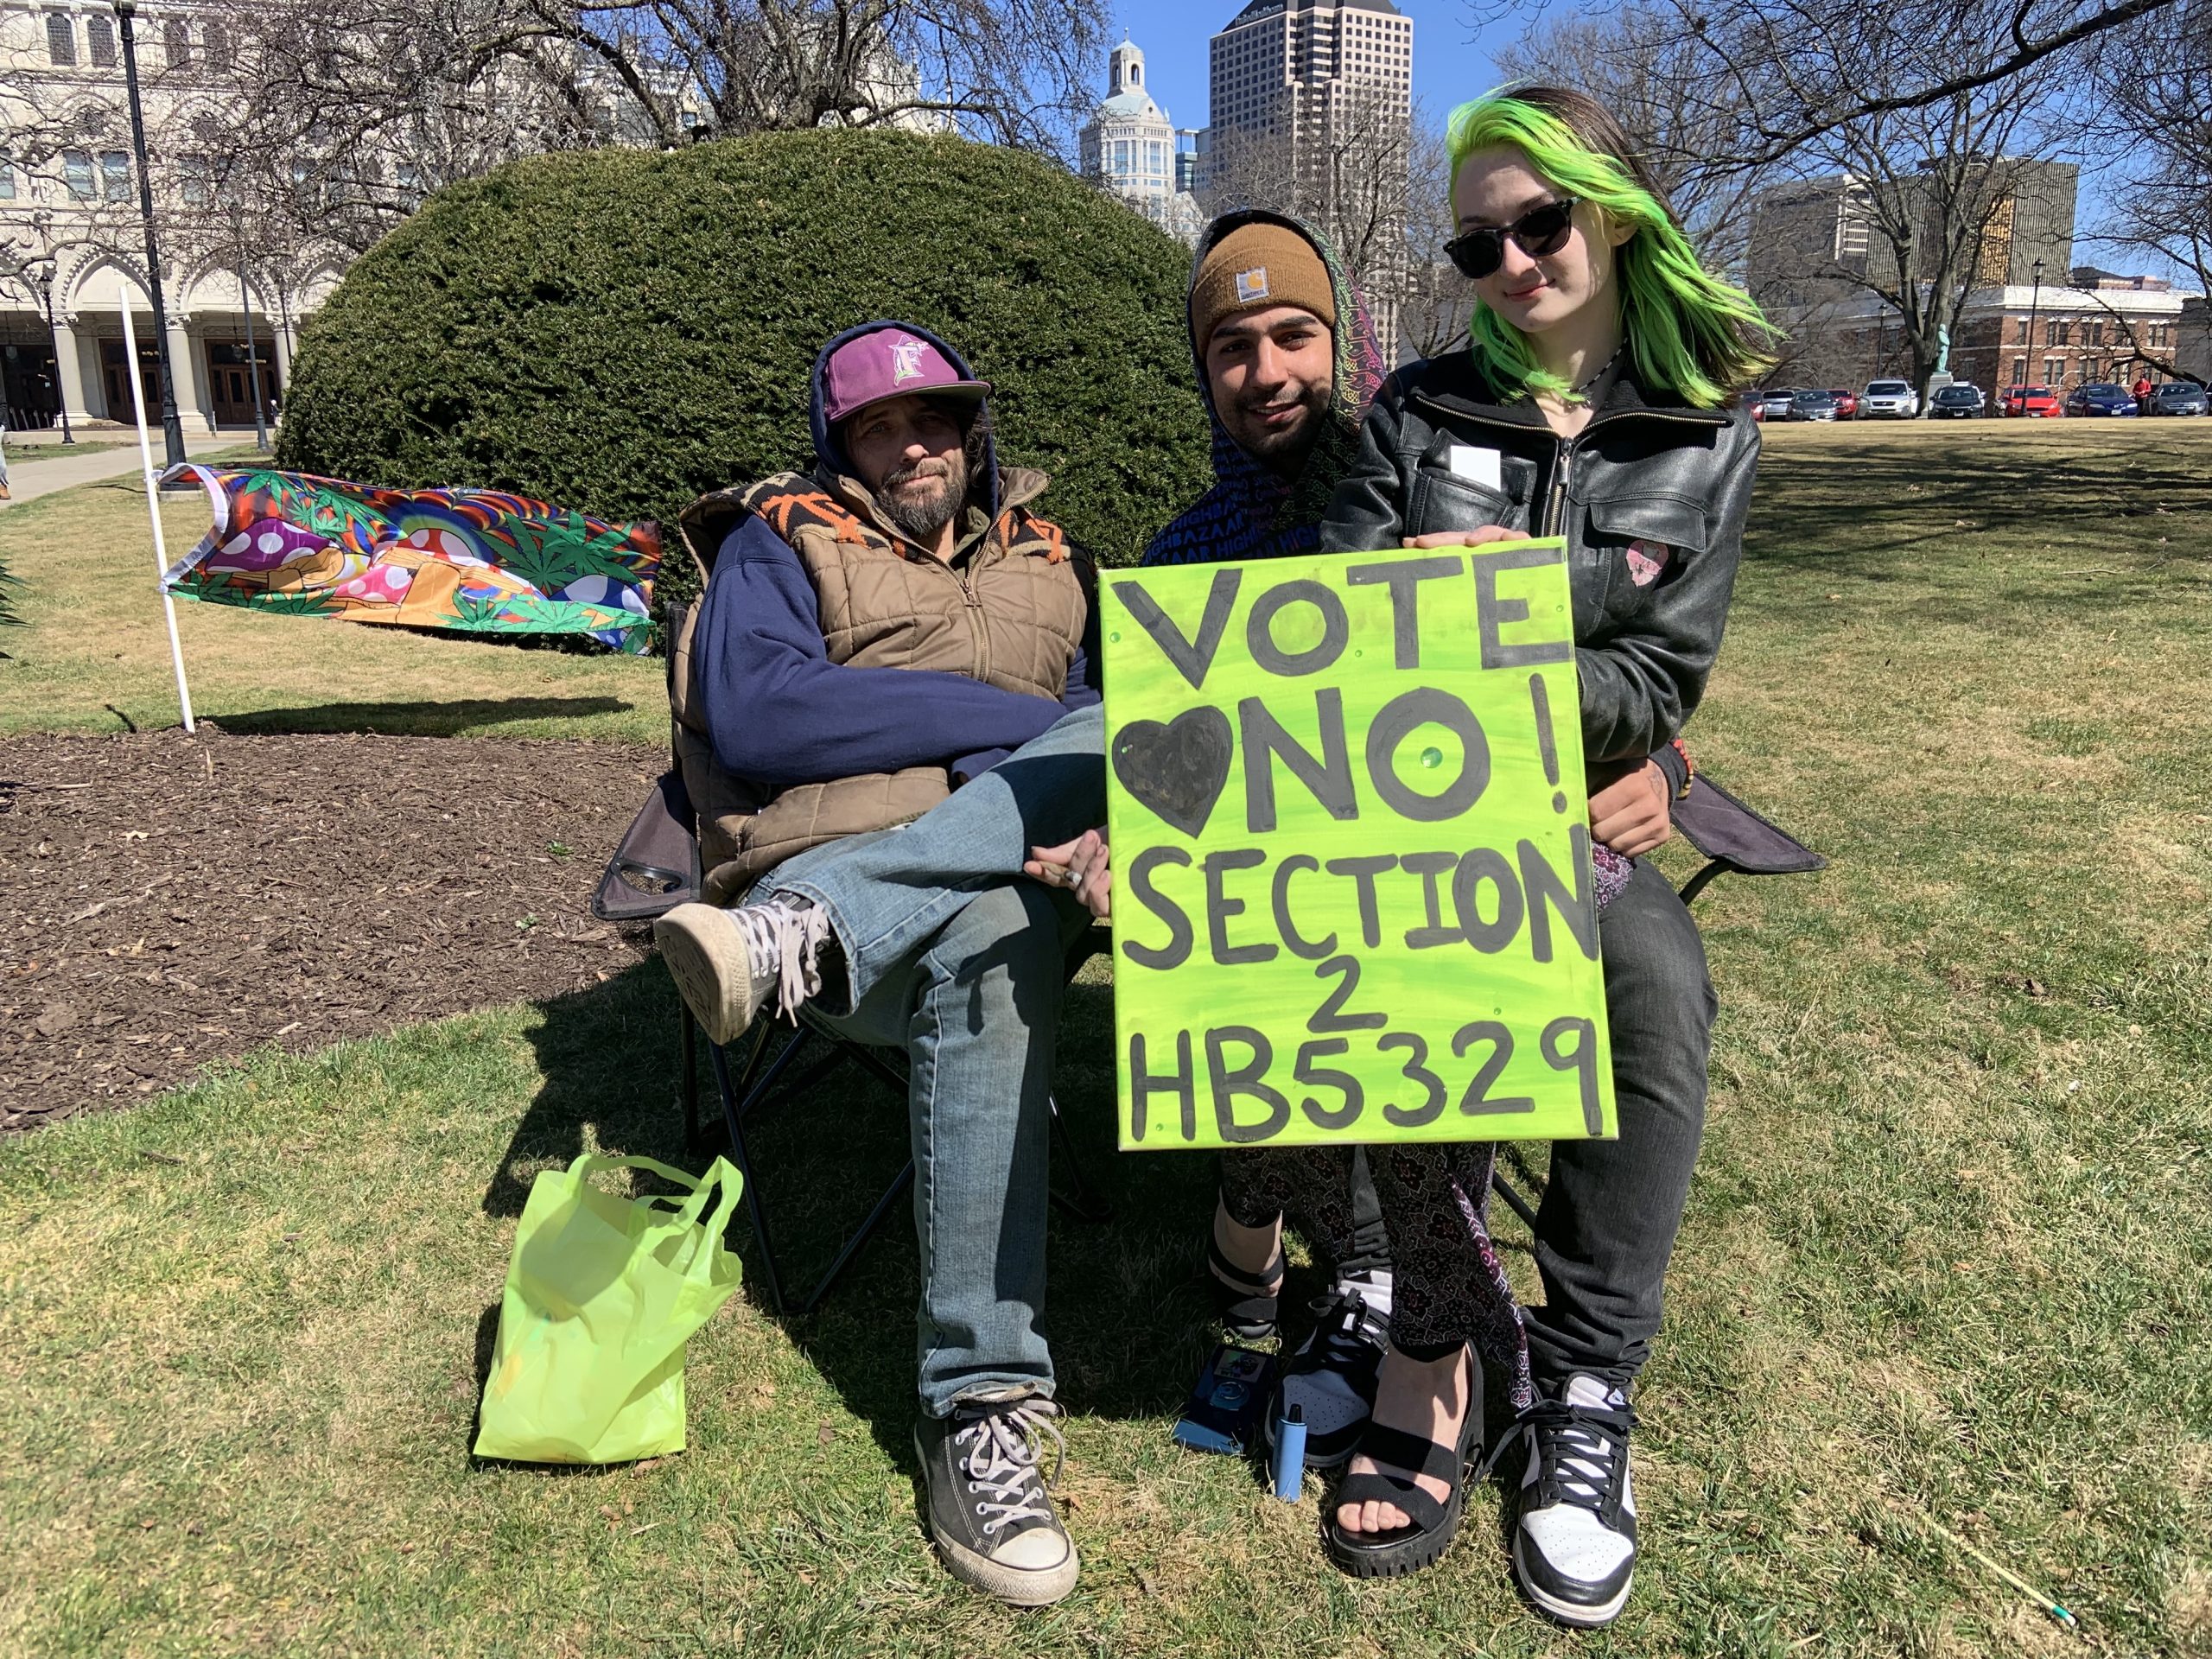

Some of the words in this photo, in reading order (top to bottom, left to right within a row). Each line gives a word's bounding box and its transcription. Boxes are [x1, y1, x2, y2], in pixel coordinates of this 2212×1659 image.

[1111, 547, 1573, 690] VOTE
[1122, 823, 1599, 969] SECTION
[1306, 955, 1388, 1033] 2
[1130, 1016, 1601, 1141] HB5329
